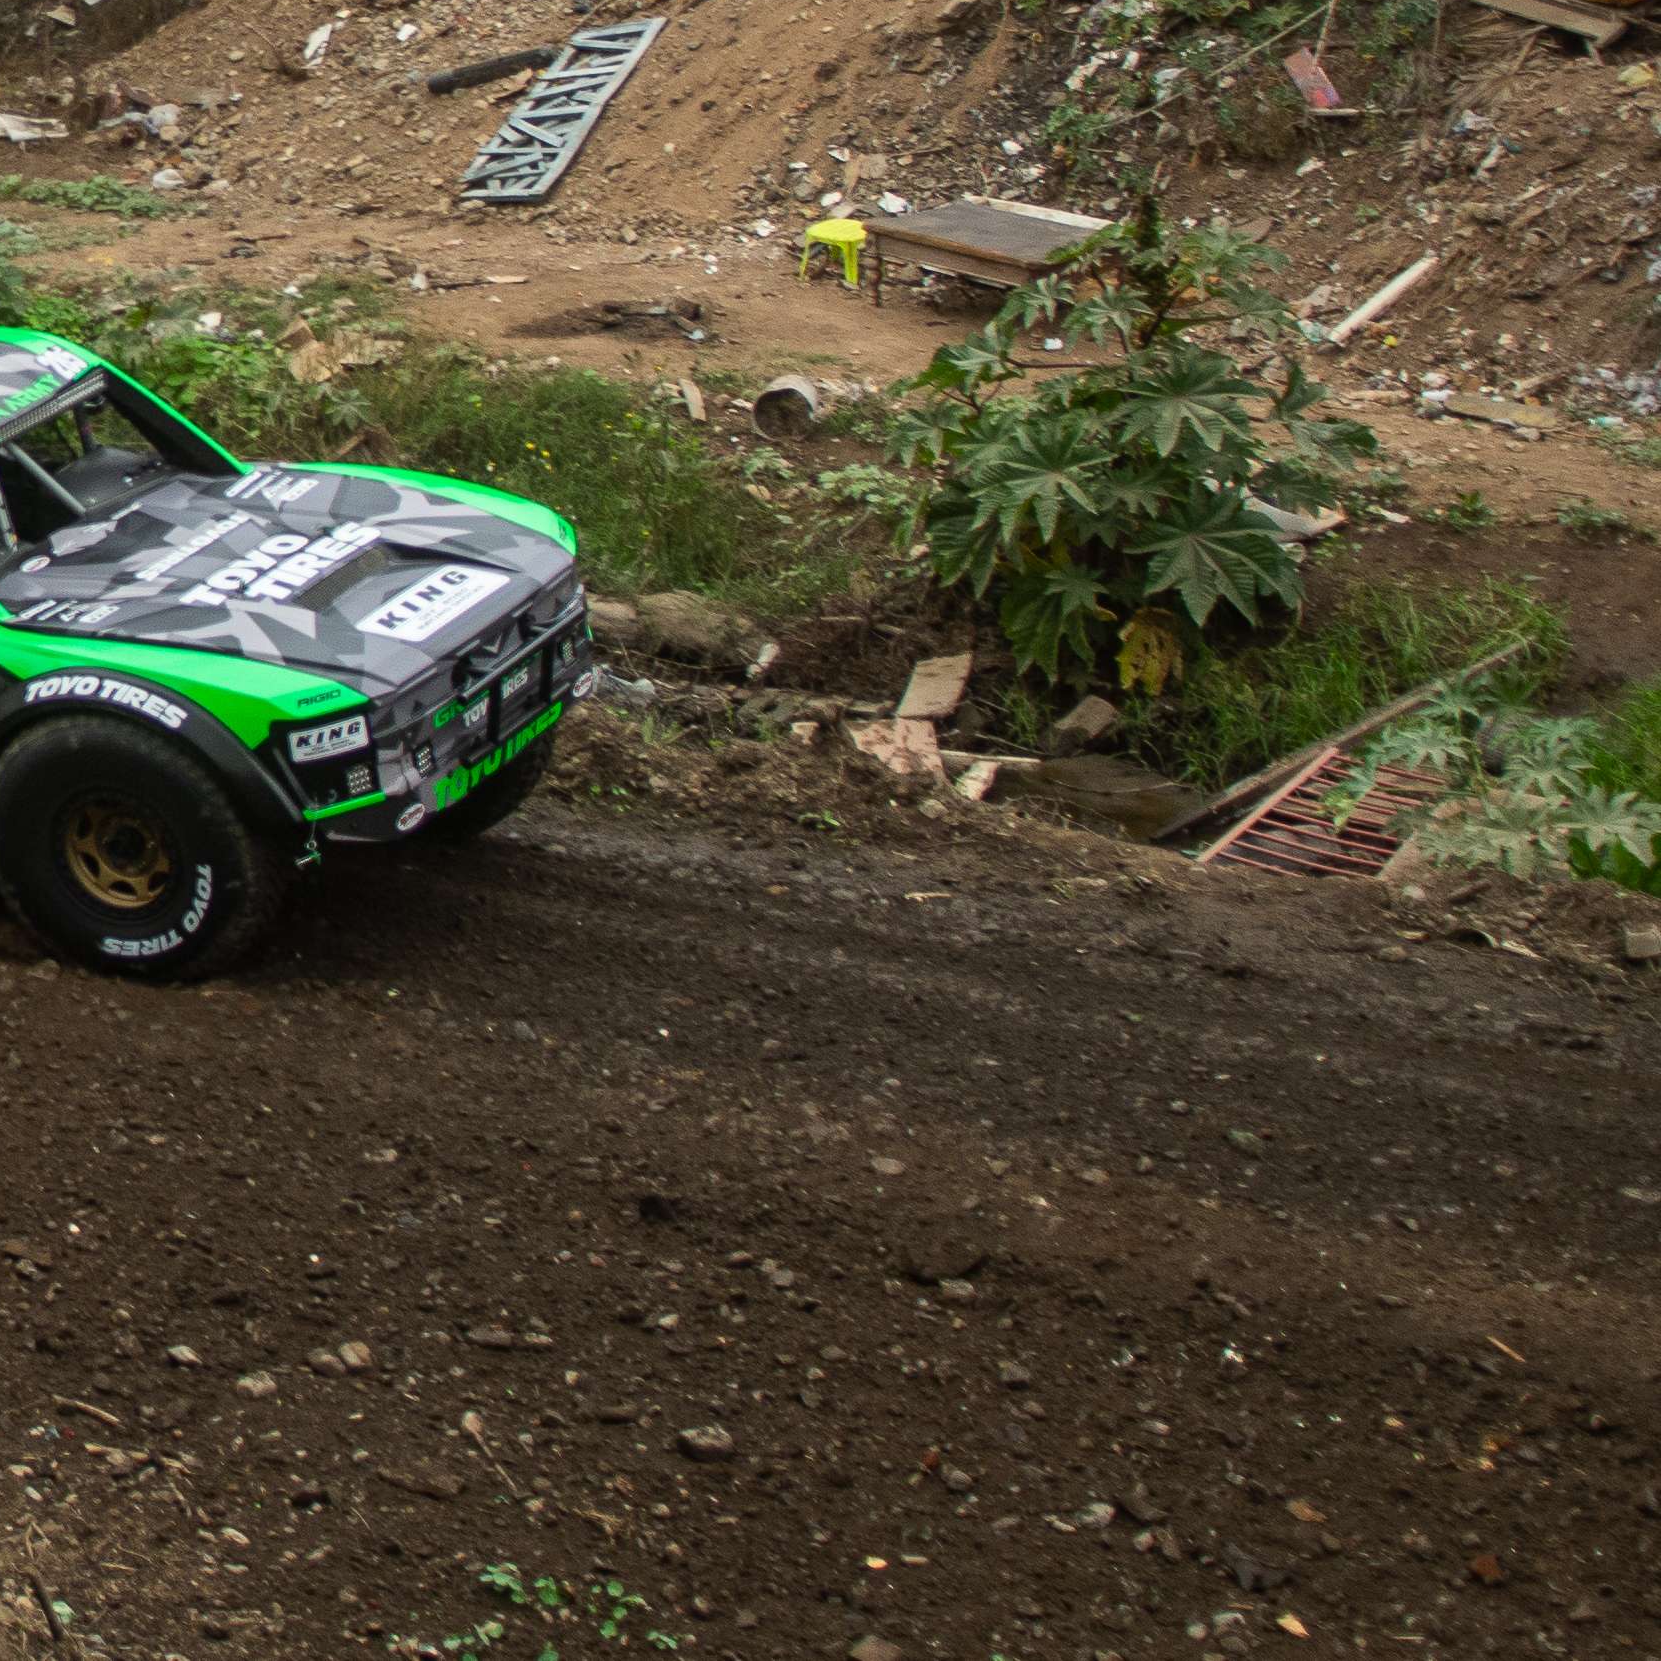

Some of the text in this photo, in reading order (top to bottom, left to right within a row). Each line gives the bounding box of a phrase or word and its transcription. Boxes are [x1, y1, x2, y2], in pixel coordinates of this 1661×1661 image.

[3, 373, 63, 411] ARMY
[179, 534, 309, 606] TOYO
[245, 521, 382, 600] TIRES
[377, 570, 470, 630] KING
[25, 675, 189, 730] TOYO TIRES
[297, 689, 342, 709] RIGID
[296, 720, 361, 747] KING
[101, 863, 213, 957] TOYO TIRES
